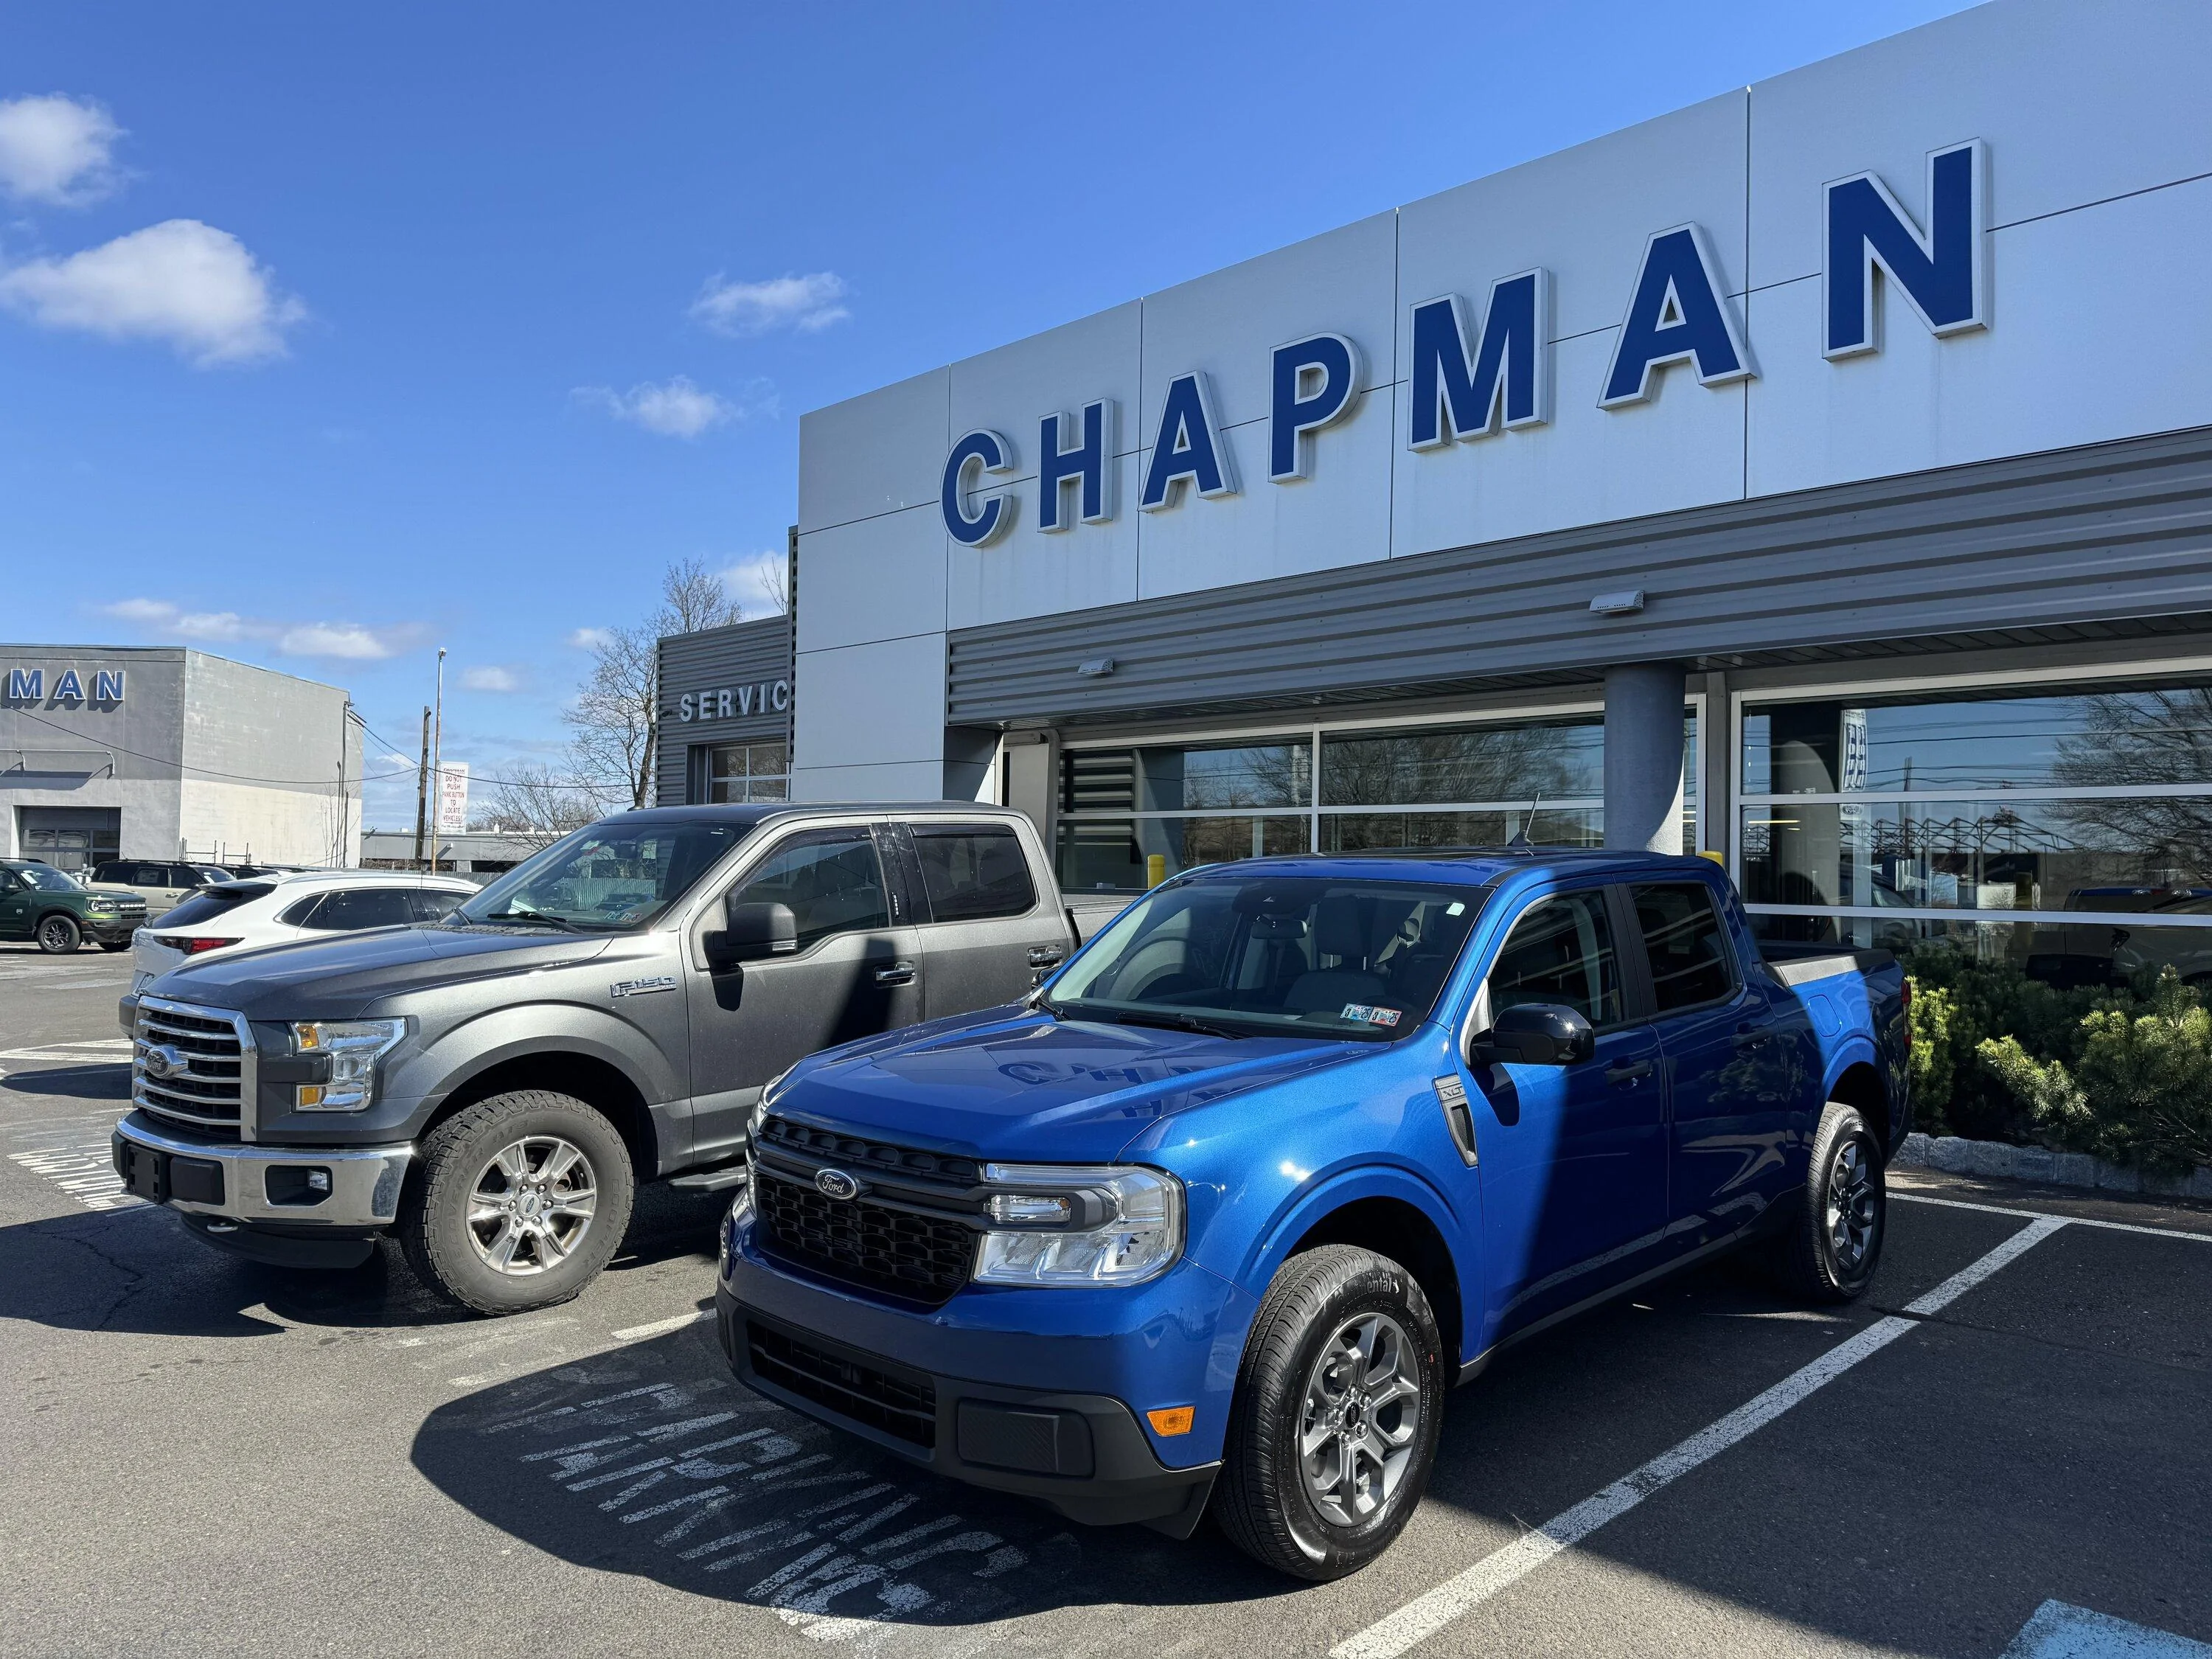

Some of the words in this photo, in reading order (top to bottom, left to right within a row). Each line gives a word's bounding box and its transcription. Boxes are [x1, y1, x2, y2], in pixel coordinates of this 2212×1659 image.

[940, 136, 1989, 549] CHAPMAN
[9, 668, 126, 700] MAN
[1443, 1088, 1462, 1097] XLT
[822, 1175, 845, 1194] Ford
